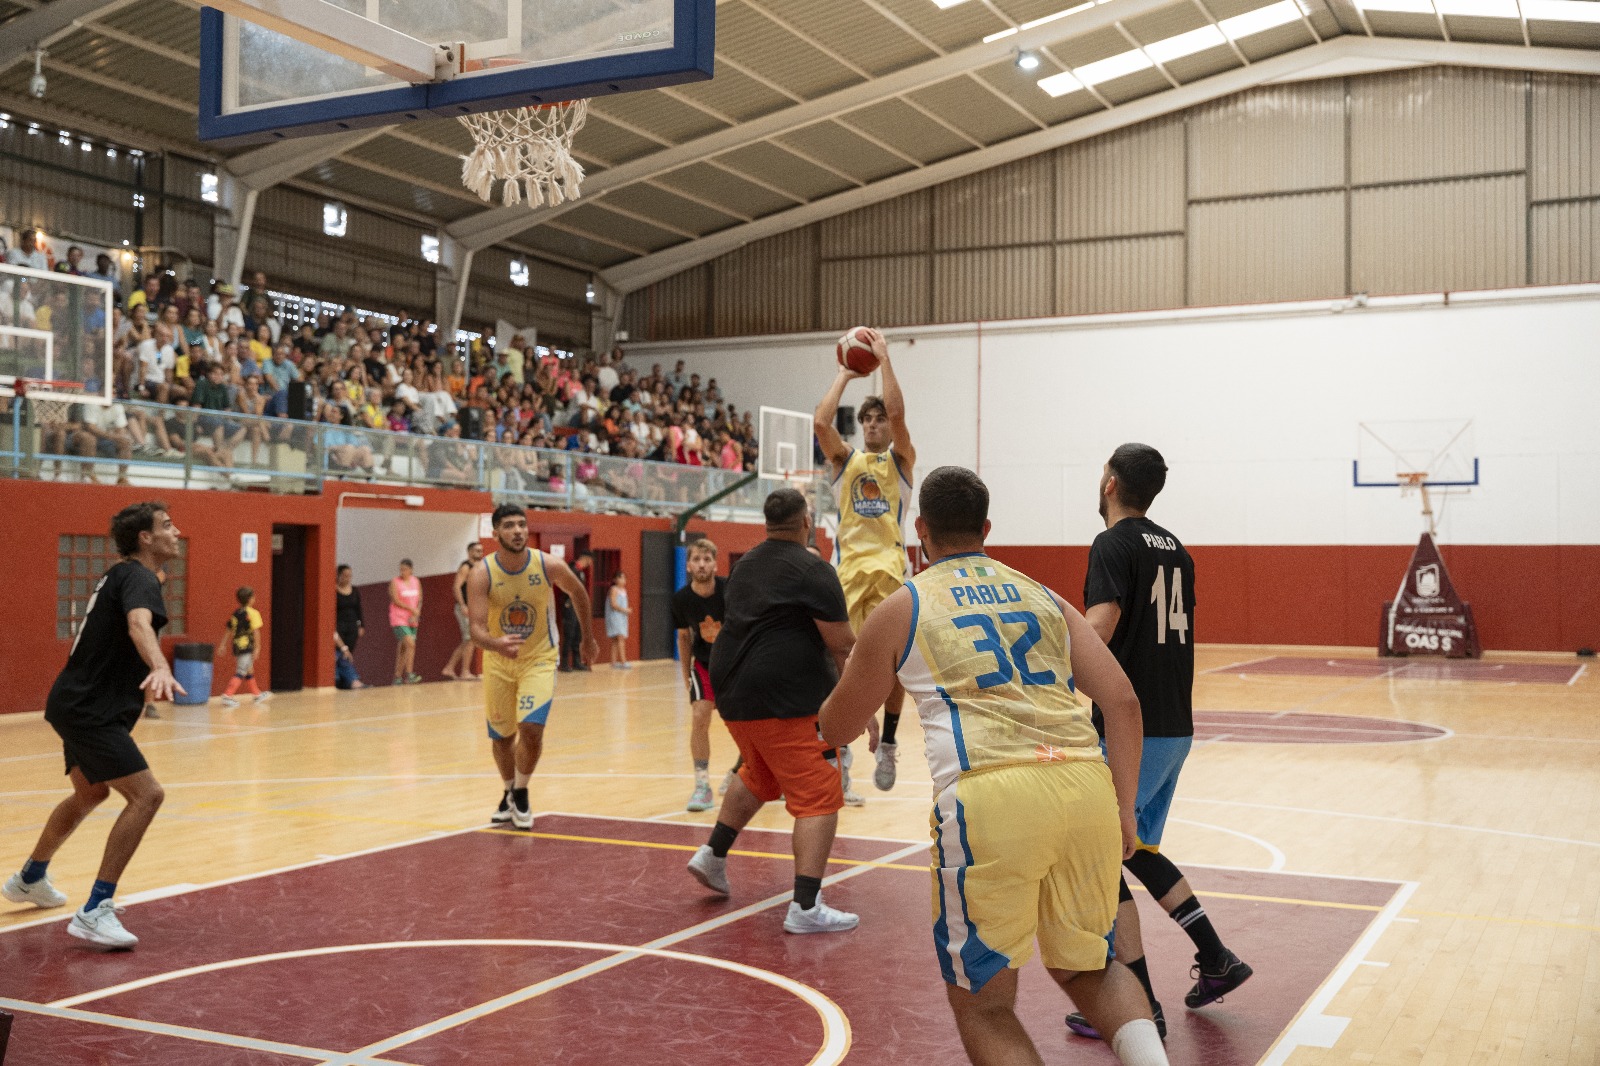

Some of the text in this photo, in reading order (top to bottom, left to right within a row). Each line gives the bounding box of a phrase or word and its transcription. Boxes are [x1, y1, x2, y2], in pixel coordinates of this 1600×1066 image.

[1141, 533, 1177, 551] PABLO
[528, 574, 541, 586] 55
[949, 583, 1022, 607] PABLO
[1150, 564, 1188, 644] 14
[950, 610, 1056, 690] 32
[519, 695, 535, 710] 55
